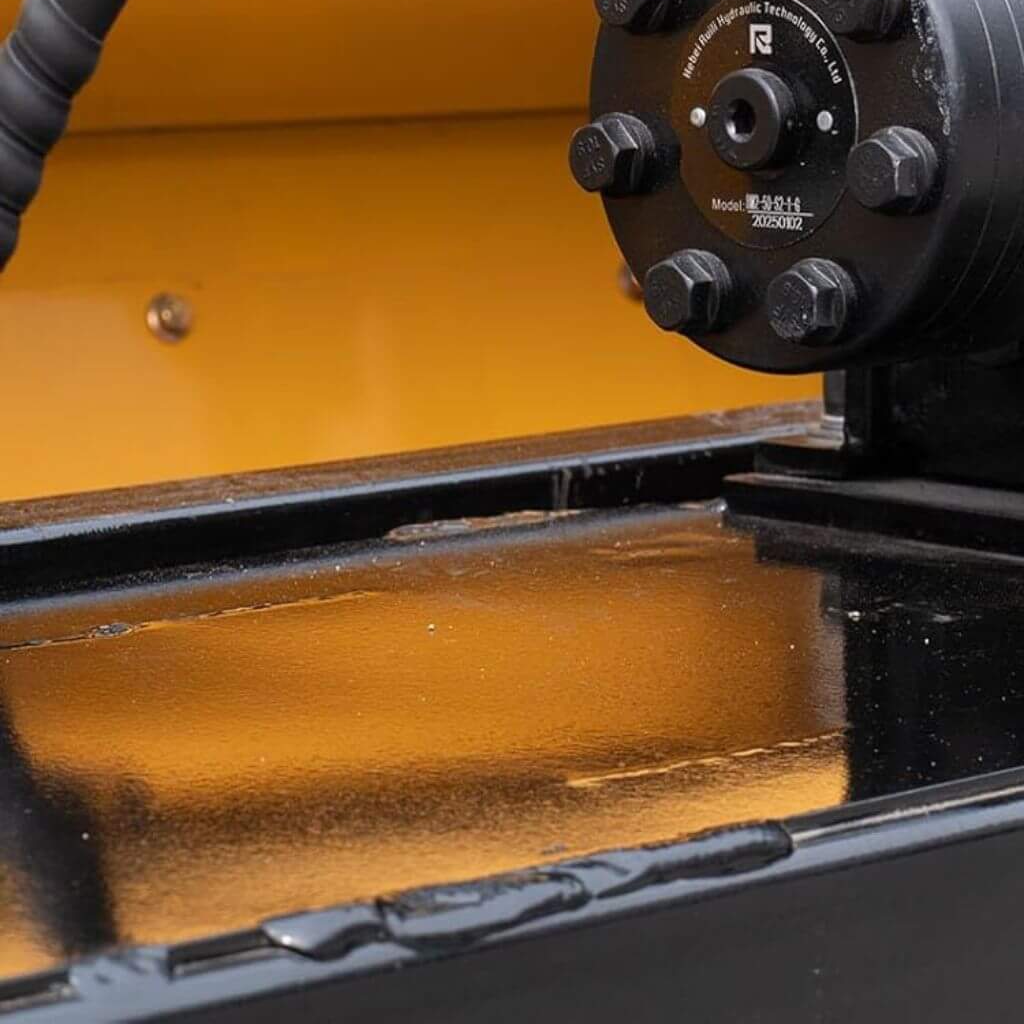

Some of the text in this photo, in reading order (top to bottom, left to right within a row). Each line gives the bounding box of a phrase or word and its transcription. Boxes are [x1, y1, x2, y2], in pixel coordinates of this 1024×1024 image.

[716, 1, 763, 27] Hydraulic
[763, 1, 818, 44] Technology
[815, 38, 829, 63] Co.,
[827, 61, 843, 84] Ltd
[711, 198, 745, 212] Model:
[751, 214, 803, 231] 20250102
